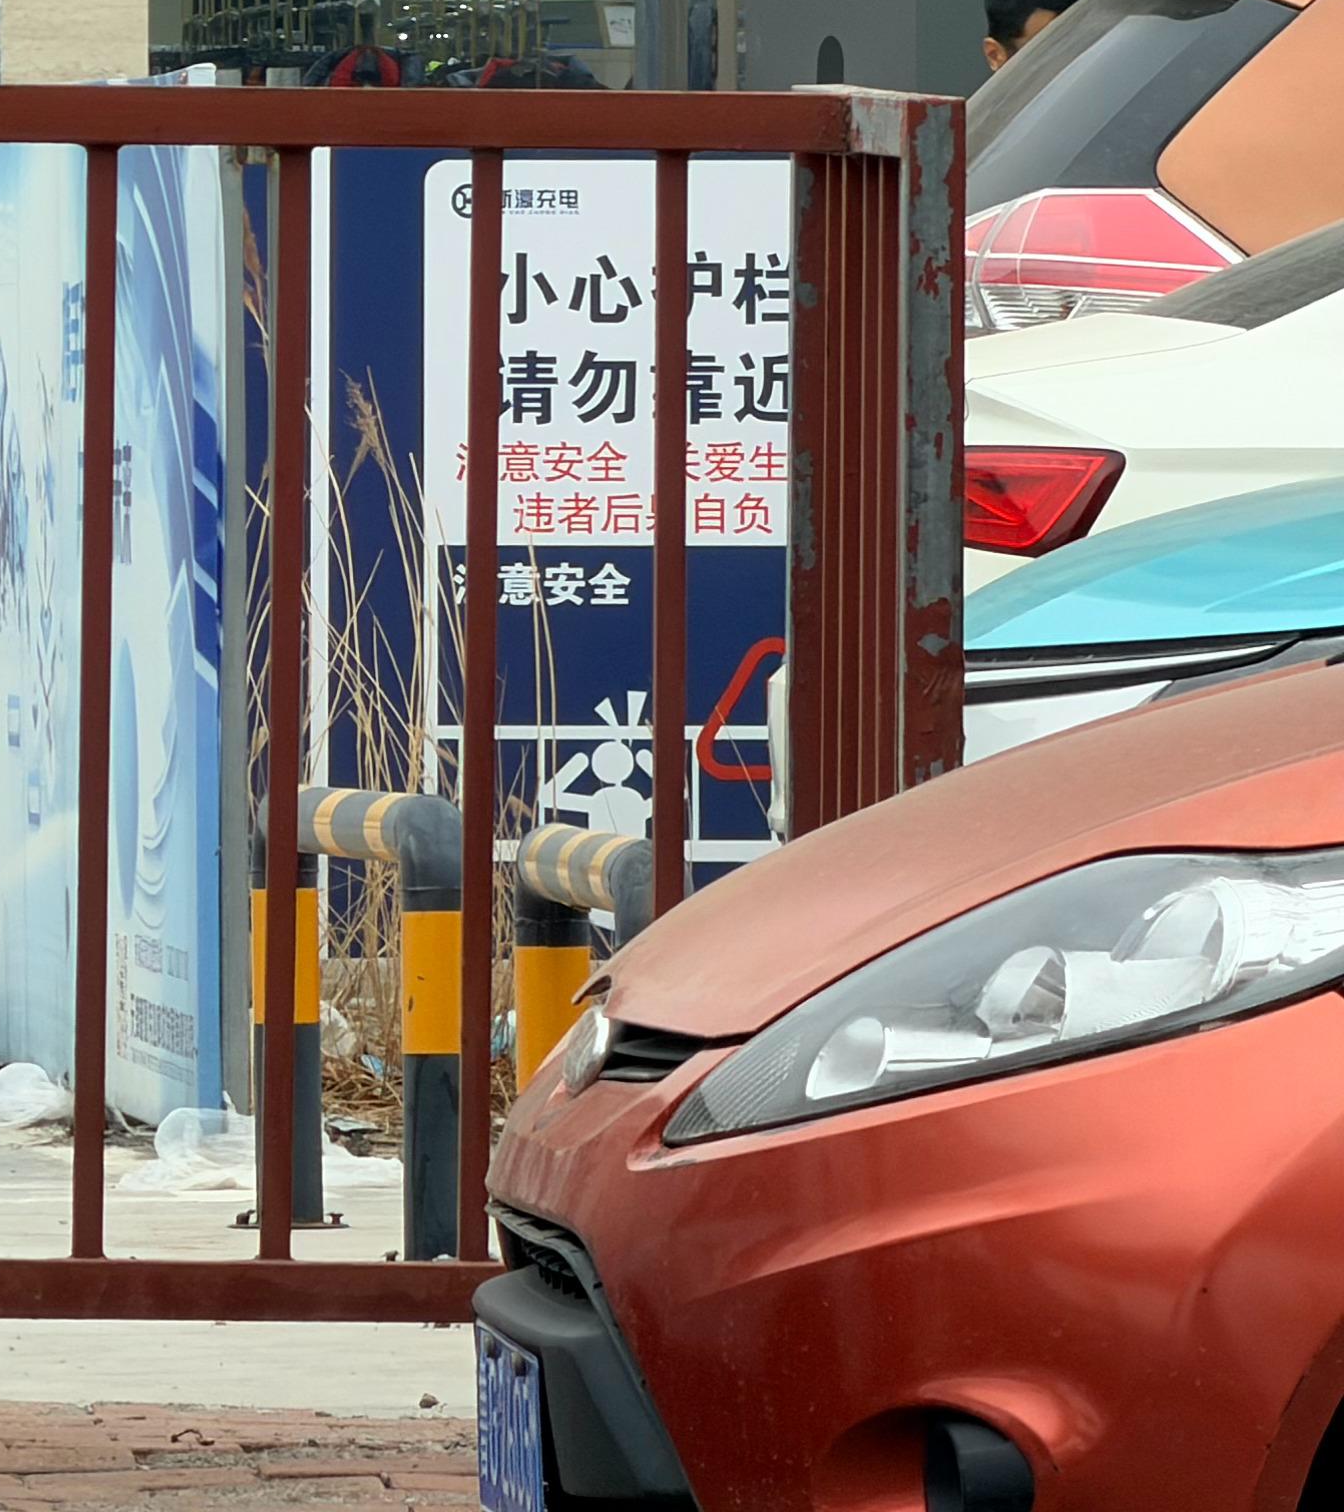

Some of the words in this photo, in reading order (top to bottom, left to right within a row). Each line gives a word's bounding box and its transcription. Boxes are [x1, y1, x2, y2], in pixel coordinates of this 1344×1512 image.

[500, 251, 790, 325] 小心护栏
[500, 350, 789, 425] 请勿靠近
[513, 492, 773, 535] 违者后自负
